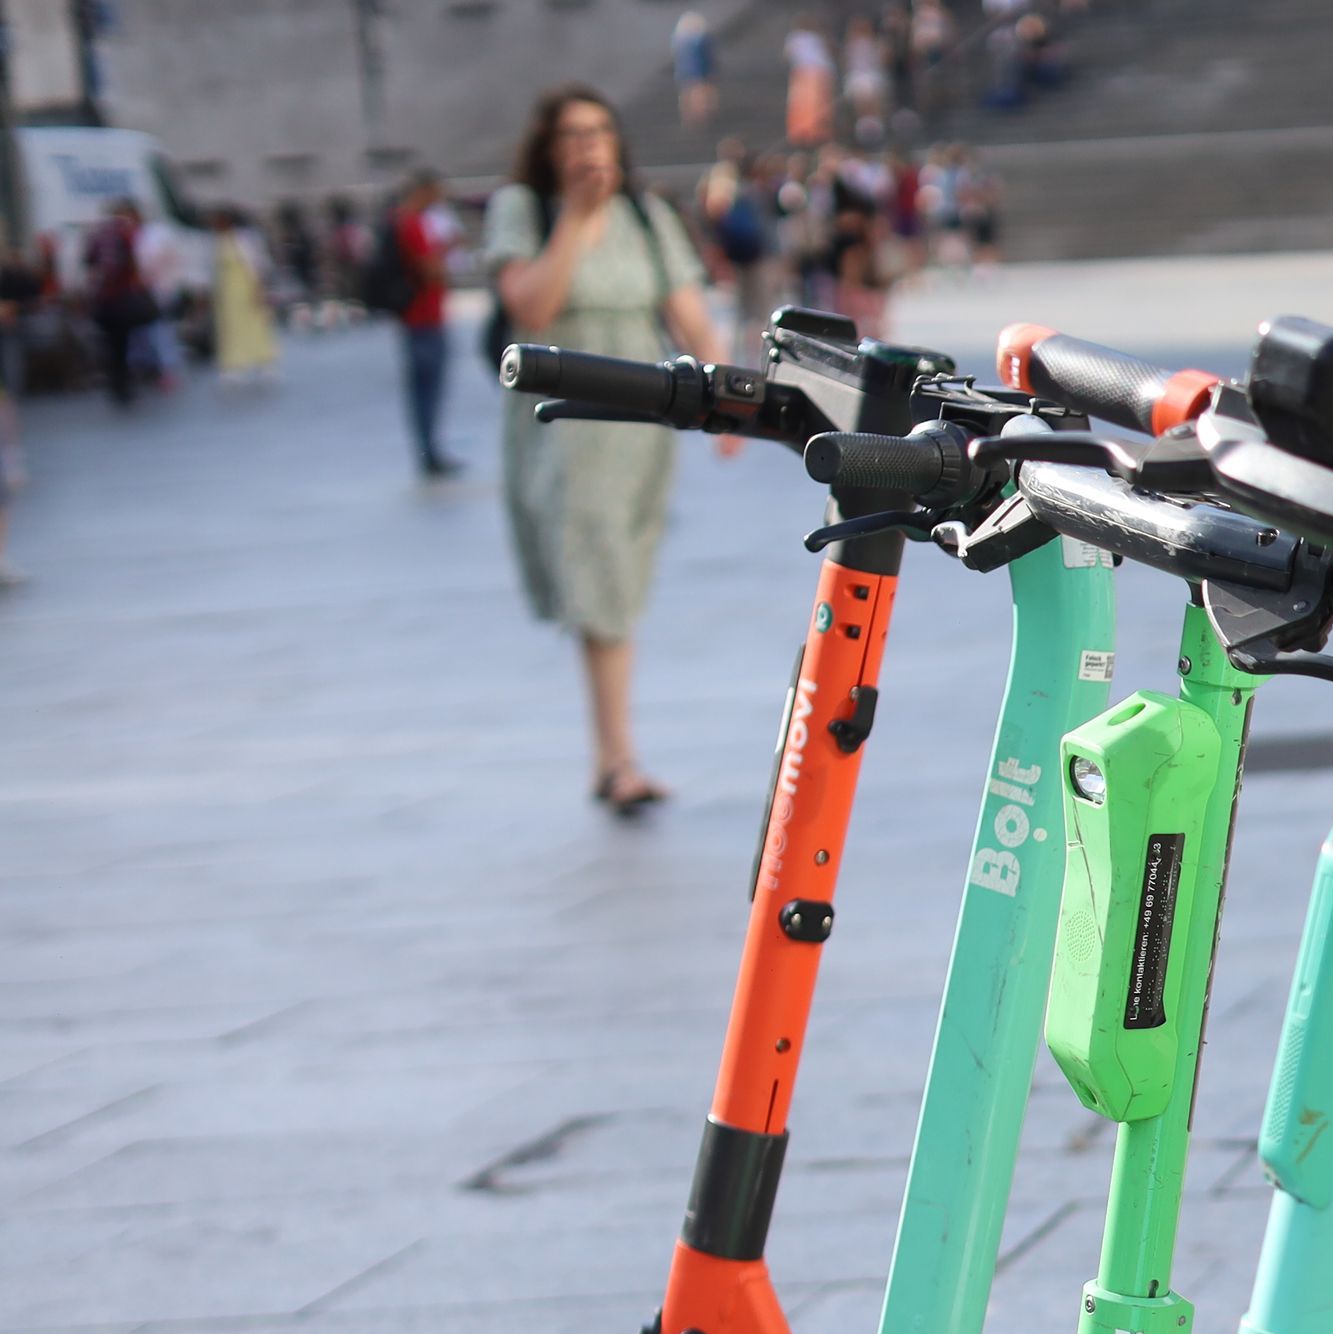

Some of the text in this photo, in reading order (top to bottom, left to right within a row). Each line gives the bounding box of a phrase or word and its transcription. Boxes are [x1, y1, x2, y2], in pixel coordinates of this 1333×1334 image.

[969, 756, 1048, 898] Bolt
[1145, 894, 1155, 908] 69
[1143, 909, 1153, 929] +49
